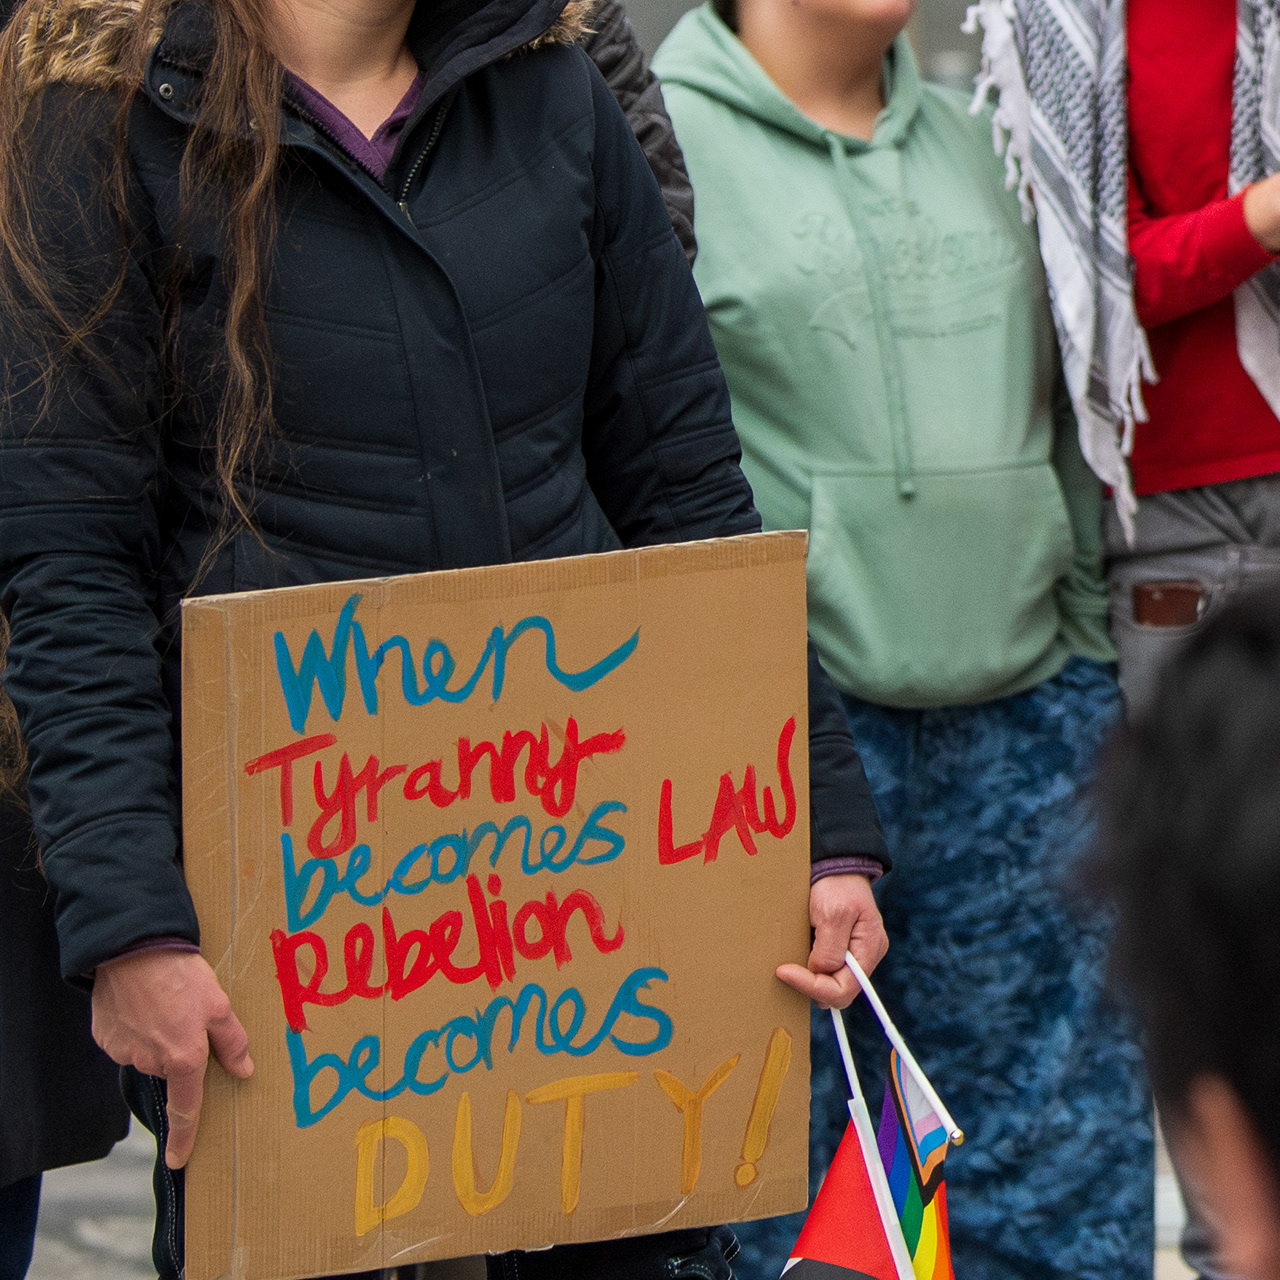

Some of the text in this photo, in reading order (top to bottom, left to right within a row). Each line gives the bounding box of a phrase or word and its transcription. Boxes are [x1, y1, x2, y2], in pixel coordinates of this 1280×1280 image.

[274, 593, 641, 734] When
[244, 714, 627, 860] Tyranny
[280, 714, 797, 933] becomes LAW
[286, 966, 674, 1128] becomes
[354, 1026, 792, 1237] DUTY!
